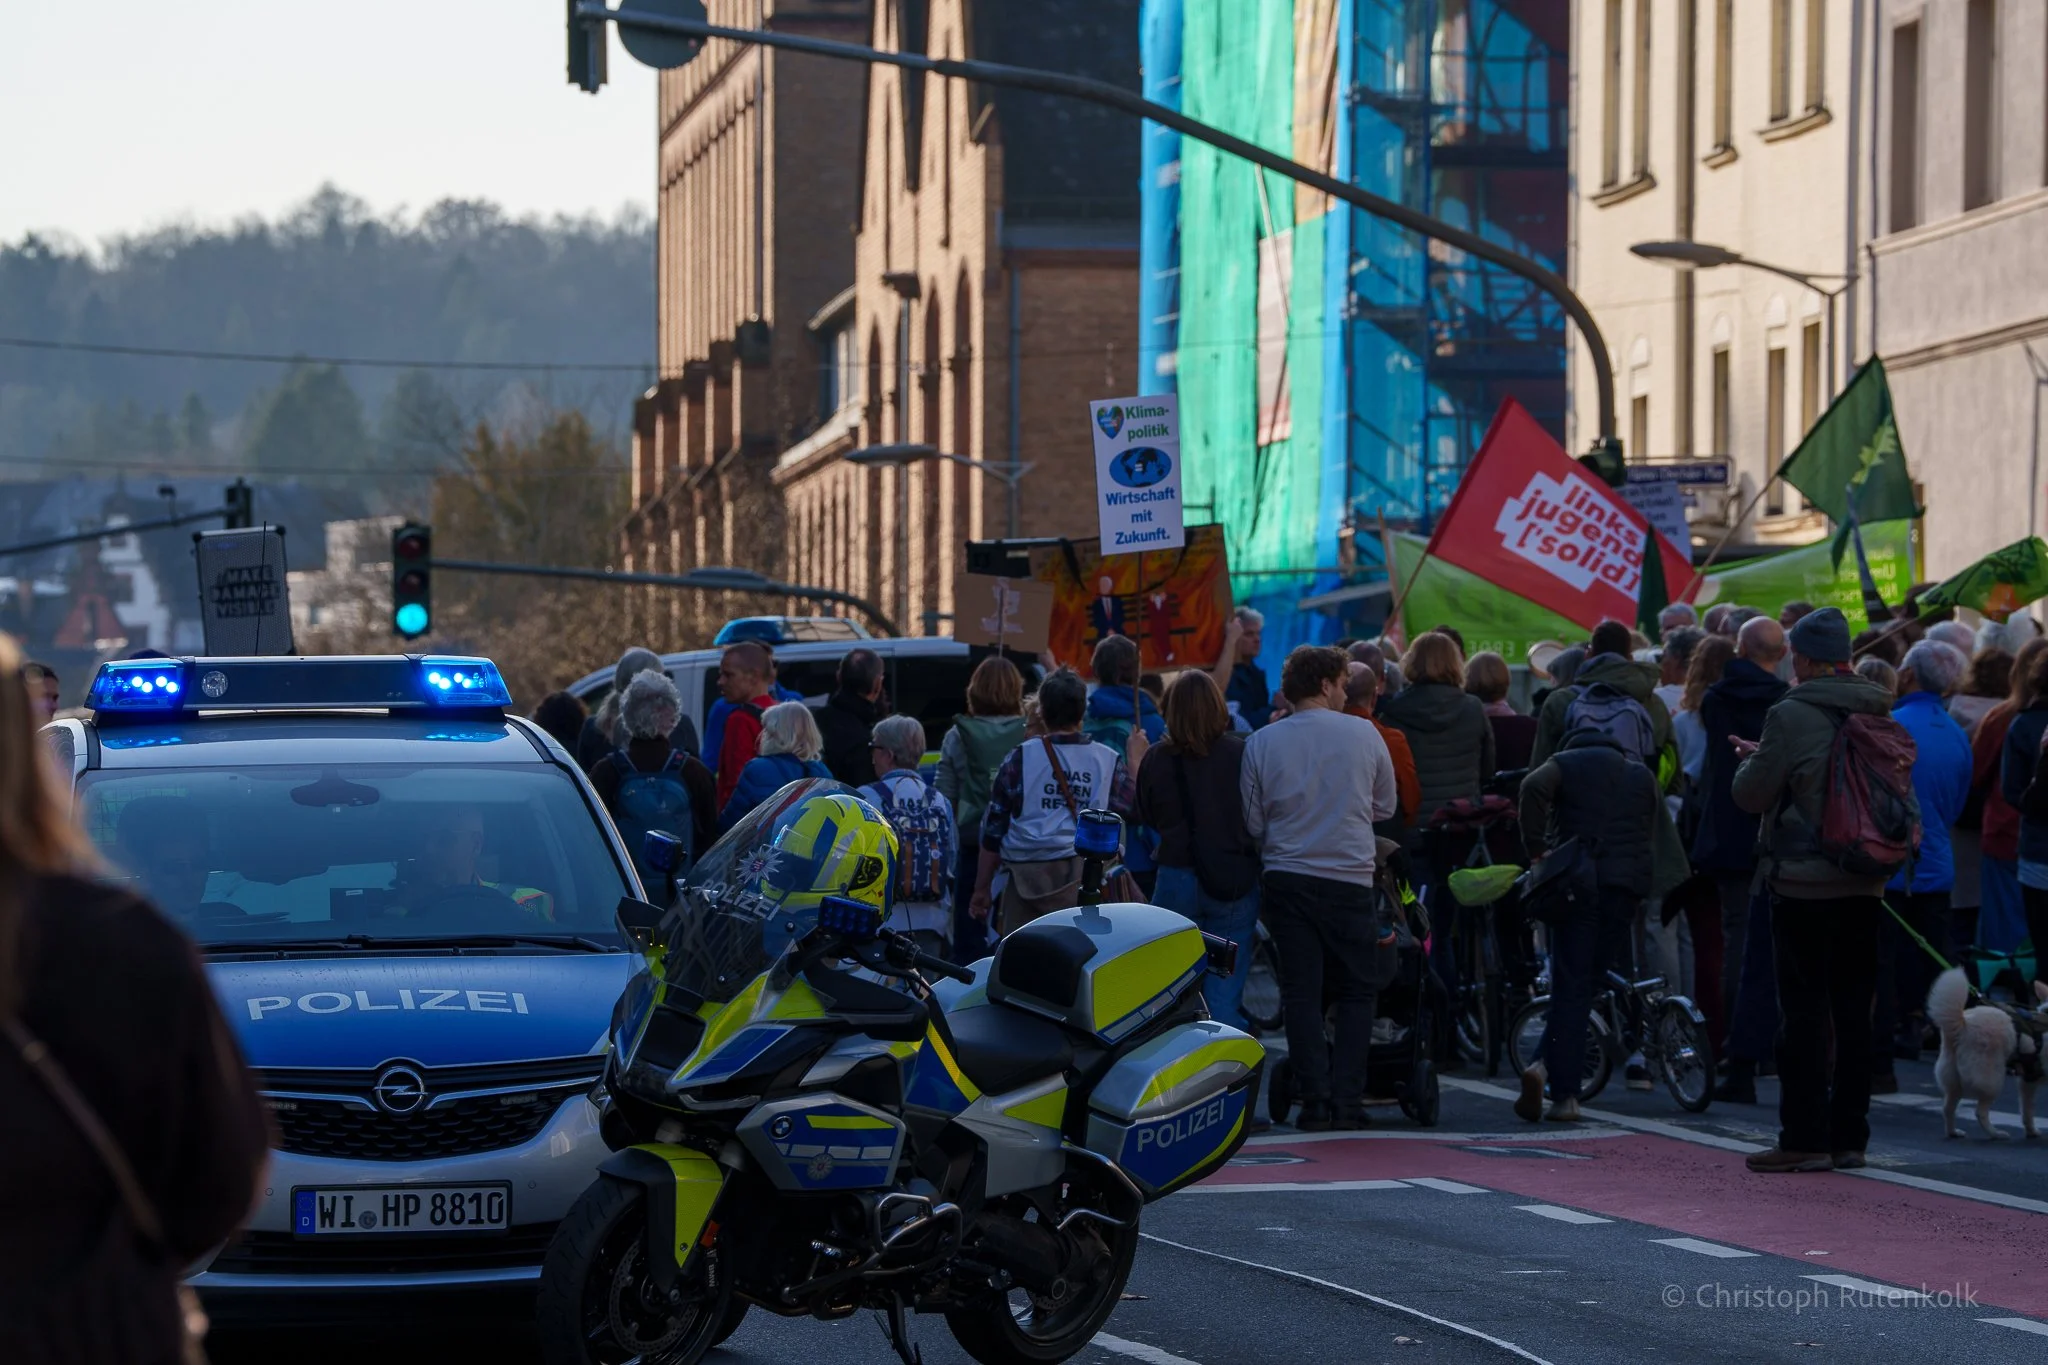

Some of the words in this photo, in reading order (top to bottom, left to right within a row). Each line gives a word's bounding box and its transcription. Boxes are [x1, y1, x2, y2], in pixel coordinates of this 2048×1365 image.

[1125, 405, 1169, 420] Klima-
[1128, 424, 1169, 442] politik
[1106, 487, 1175, 506] Wirtschaft
[1131, 509, 1153, 523] mit
[1515, 489, 1643, 568] jugend
[1563, 484, 1640, 546] links
[1115, 527, 1171, 546] Zukunft.
[700, 879, 781, 921] POLIZEI
[247, 989, 529, 1021] POLIZEI
[1137, 1098, 1225, 1153] POLIZEI
[318, 1195, 356, 1228] WI
[382, 1194, 421, 1227] HP
[430, 1192, 504, 1226] 8810
